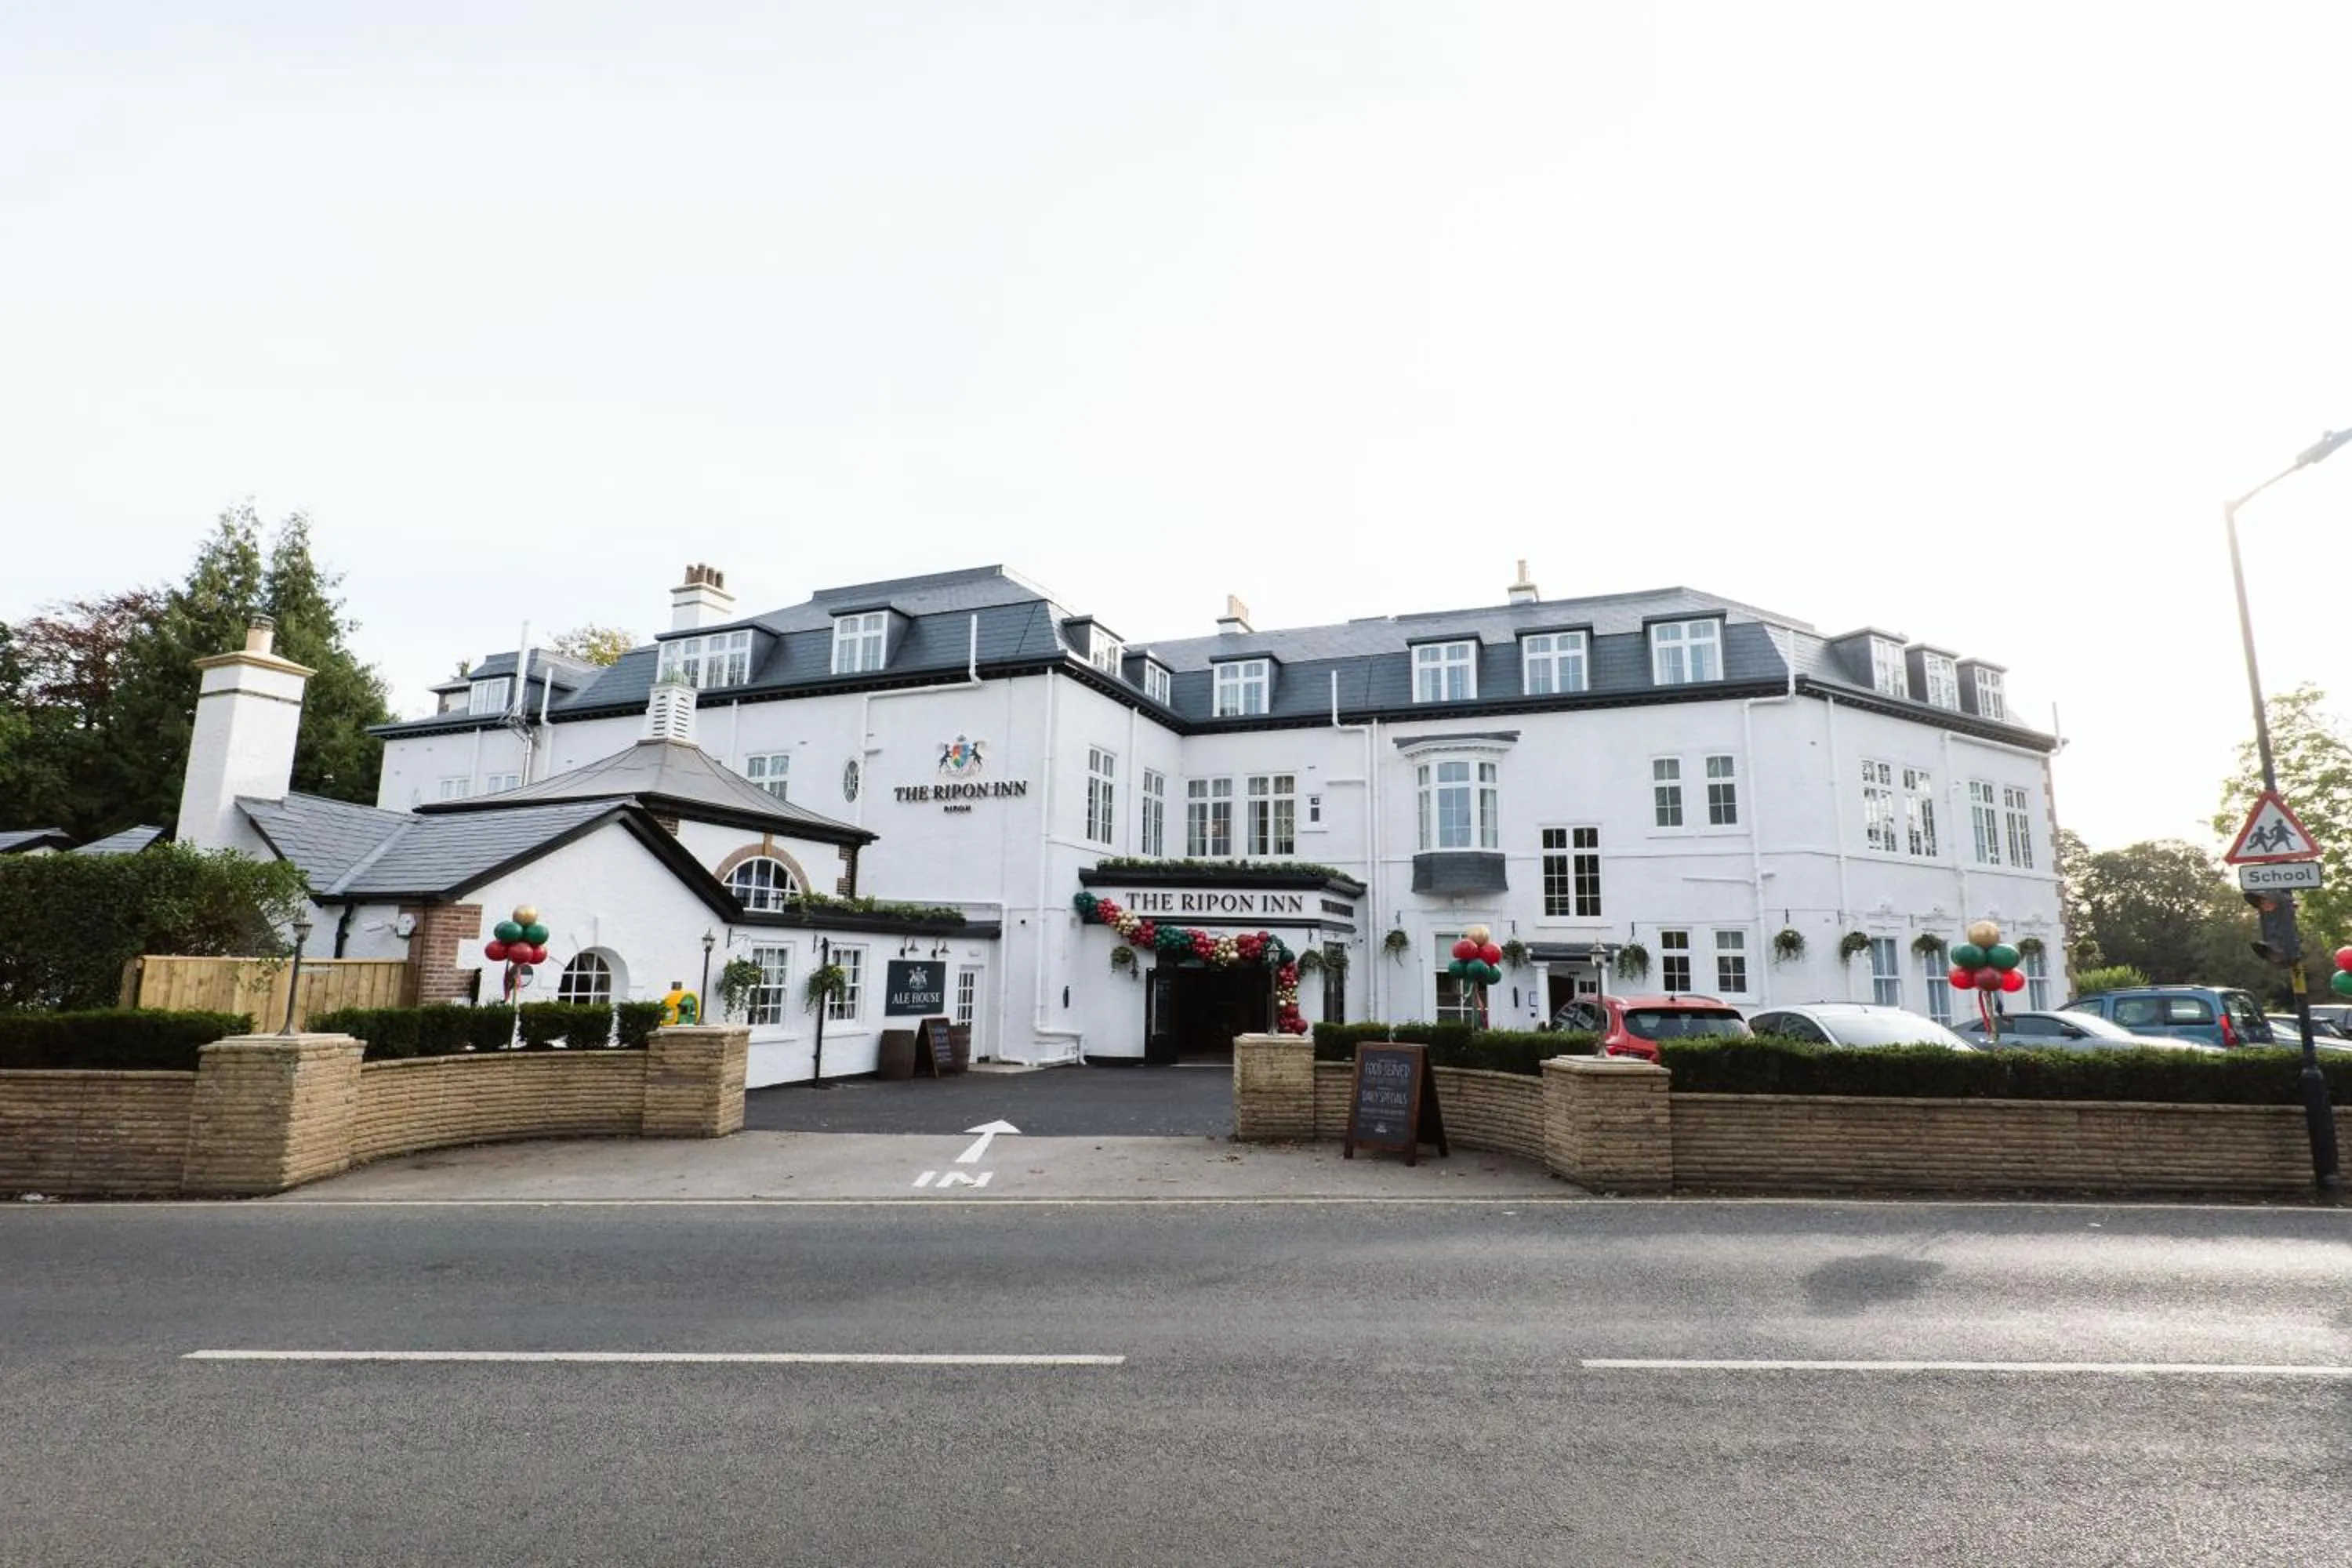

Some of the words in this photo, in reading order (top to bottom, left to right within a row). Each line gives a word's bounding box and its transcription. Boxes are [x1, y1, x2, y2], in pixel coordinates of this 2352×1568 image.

[894, 786, 929, 801] THE
[934, 783, 989, 800] RIPON
[993, 781, 1027, 797] INN
[2249, 868, 2313, 883] School
[1126, 892, 1173, 910] THE
[1181, 894, 1254, 912] RIPON
[1261, 895, 1303, 913] INN
[892, 993, 909, 1004] ALE
[912, 992, 941, 1004] HOUSE
[913, 1171, 993, 1188] IN
